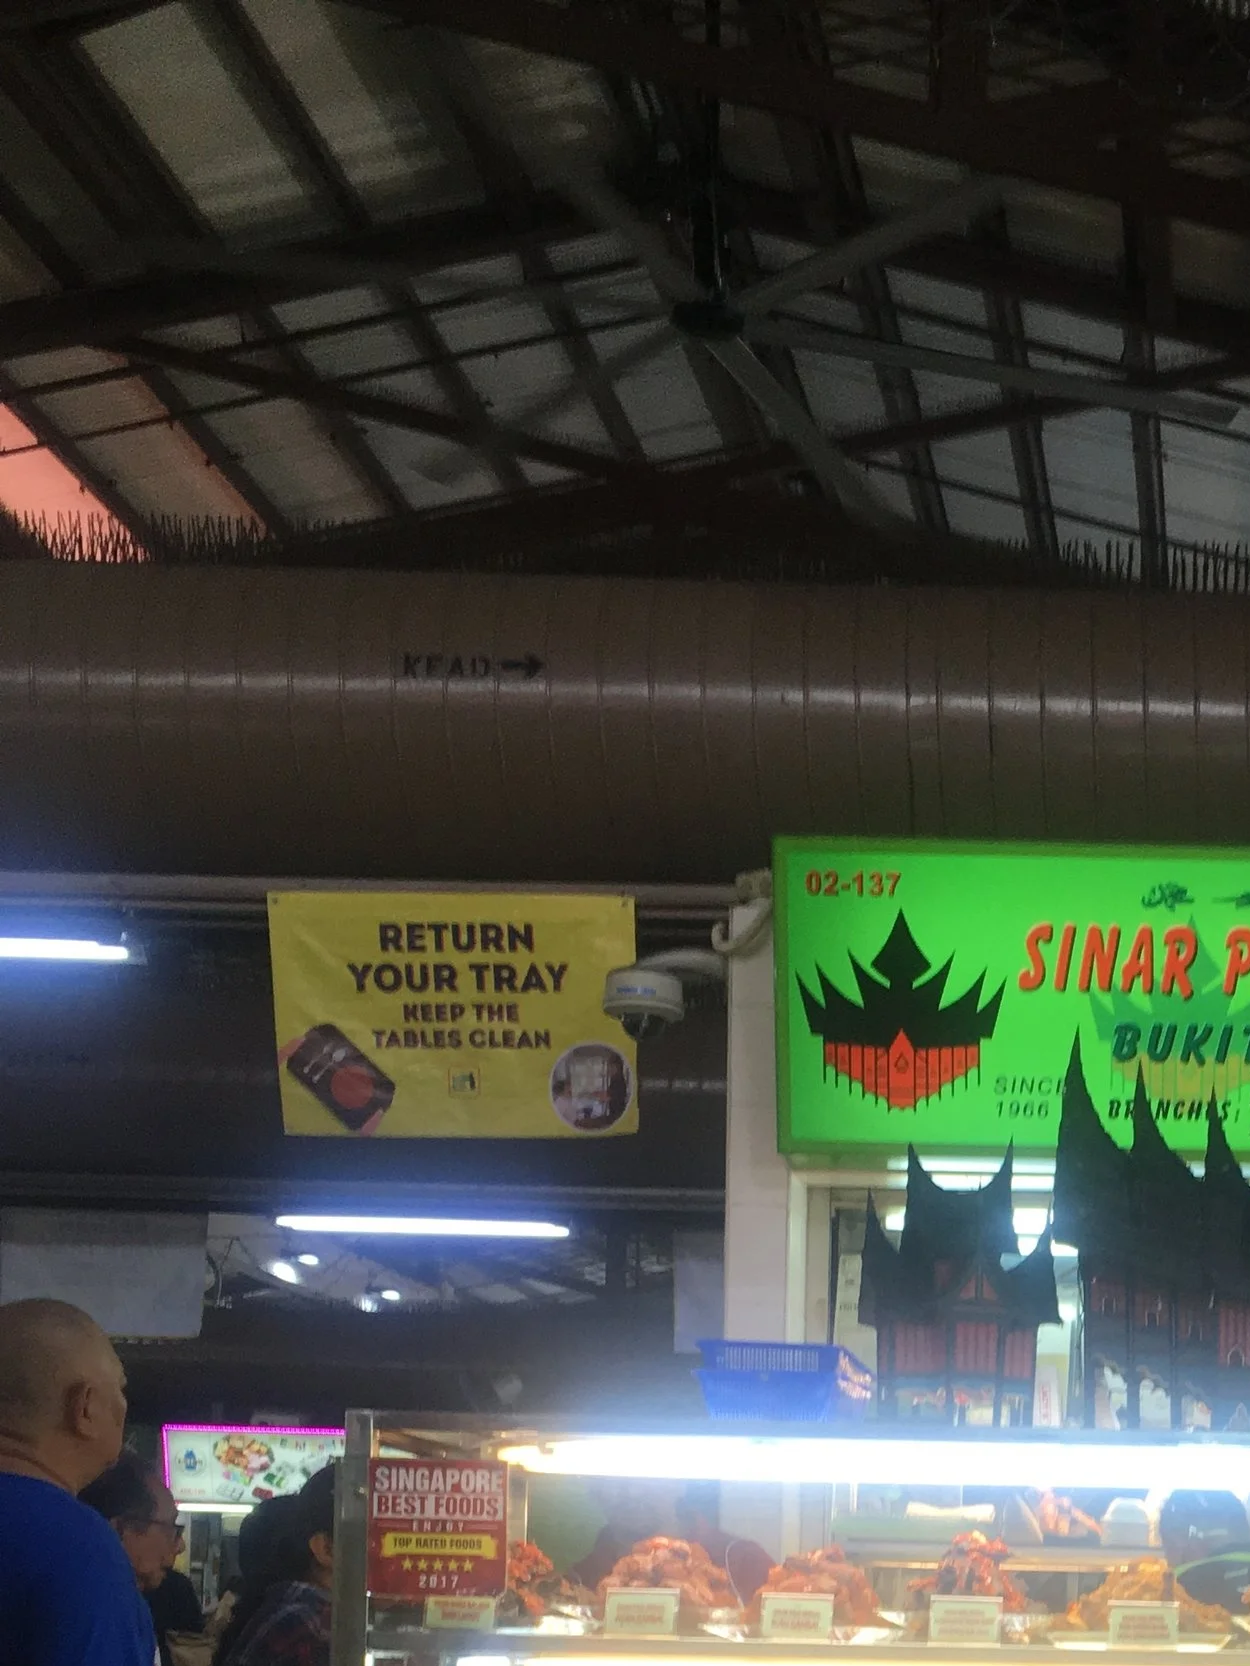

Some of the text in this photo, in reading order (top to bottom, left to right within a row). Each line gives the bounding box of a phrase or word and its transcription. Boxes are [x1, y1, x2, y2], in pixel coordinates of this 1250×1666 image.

[805, 870, 902, 897] 02-137
[378, 921, 536, 954] RETURN
[1018, 922, 1199, 1000] SINAR
[347, 962, 569, 995] YOUR TRAY
[402, 1002, 520, 1024] KEEP THE
[372, 1028, 552, 1051] TABLES CLEAN
[996, 1099, 1050, 1120] 1966
[374, 1465, 504, 1493] SINGAPORE
[376, 1494, 500, 1518] BEST FOODS
[412, 1520, 464, 1533] ENJOY
[393, 1537, 412, 1549] TOP
[418, 1574, 459, 1590] 2017
